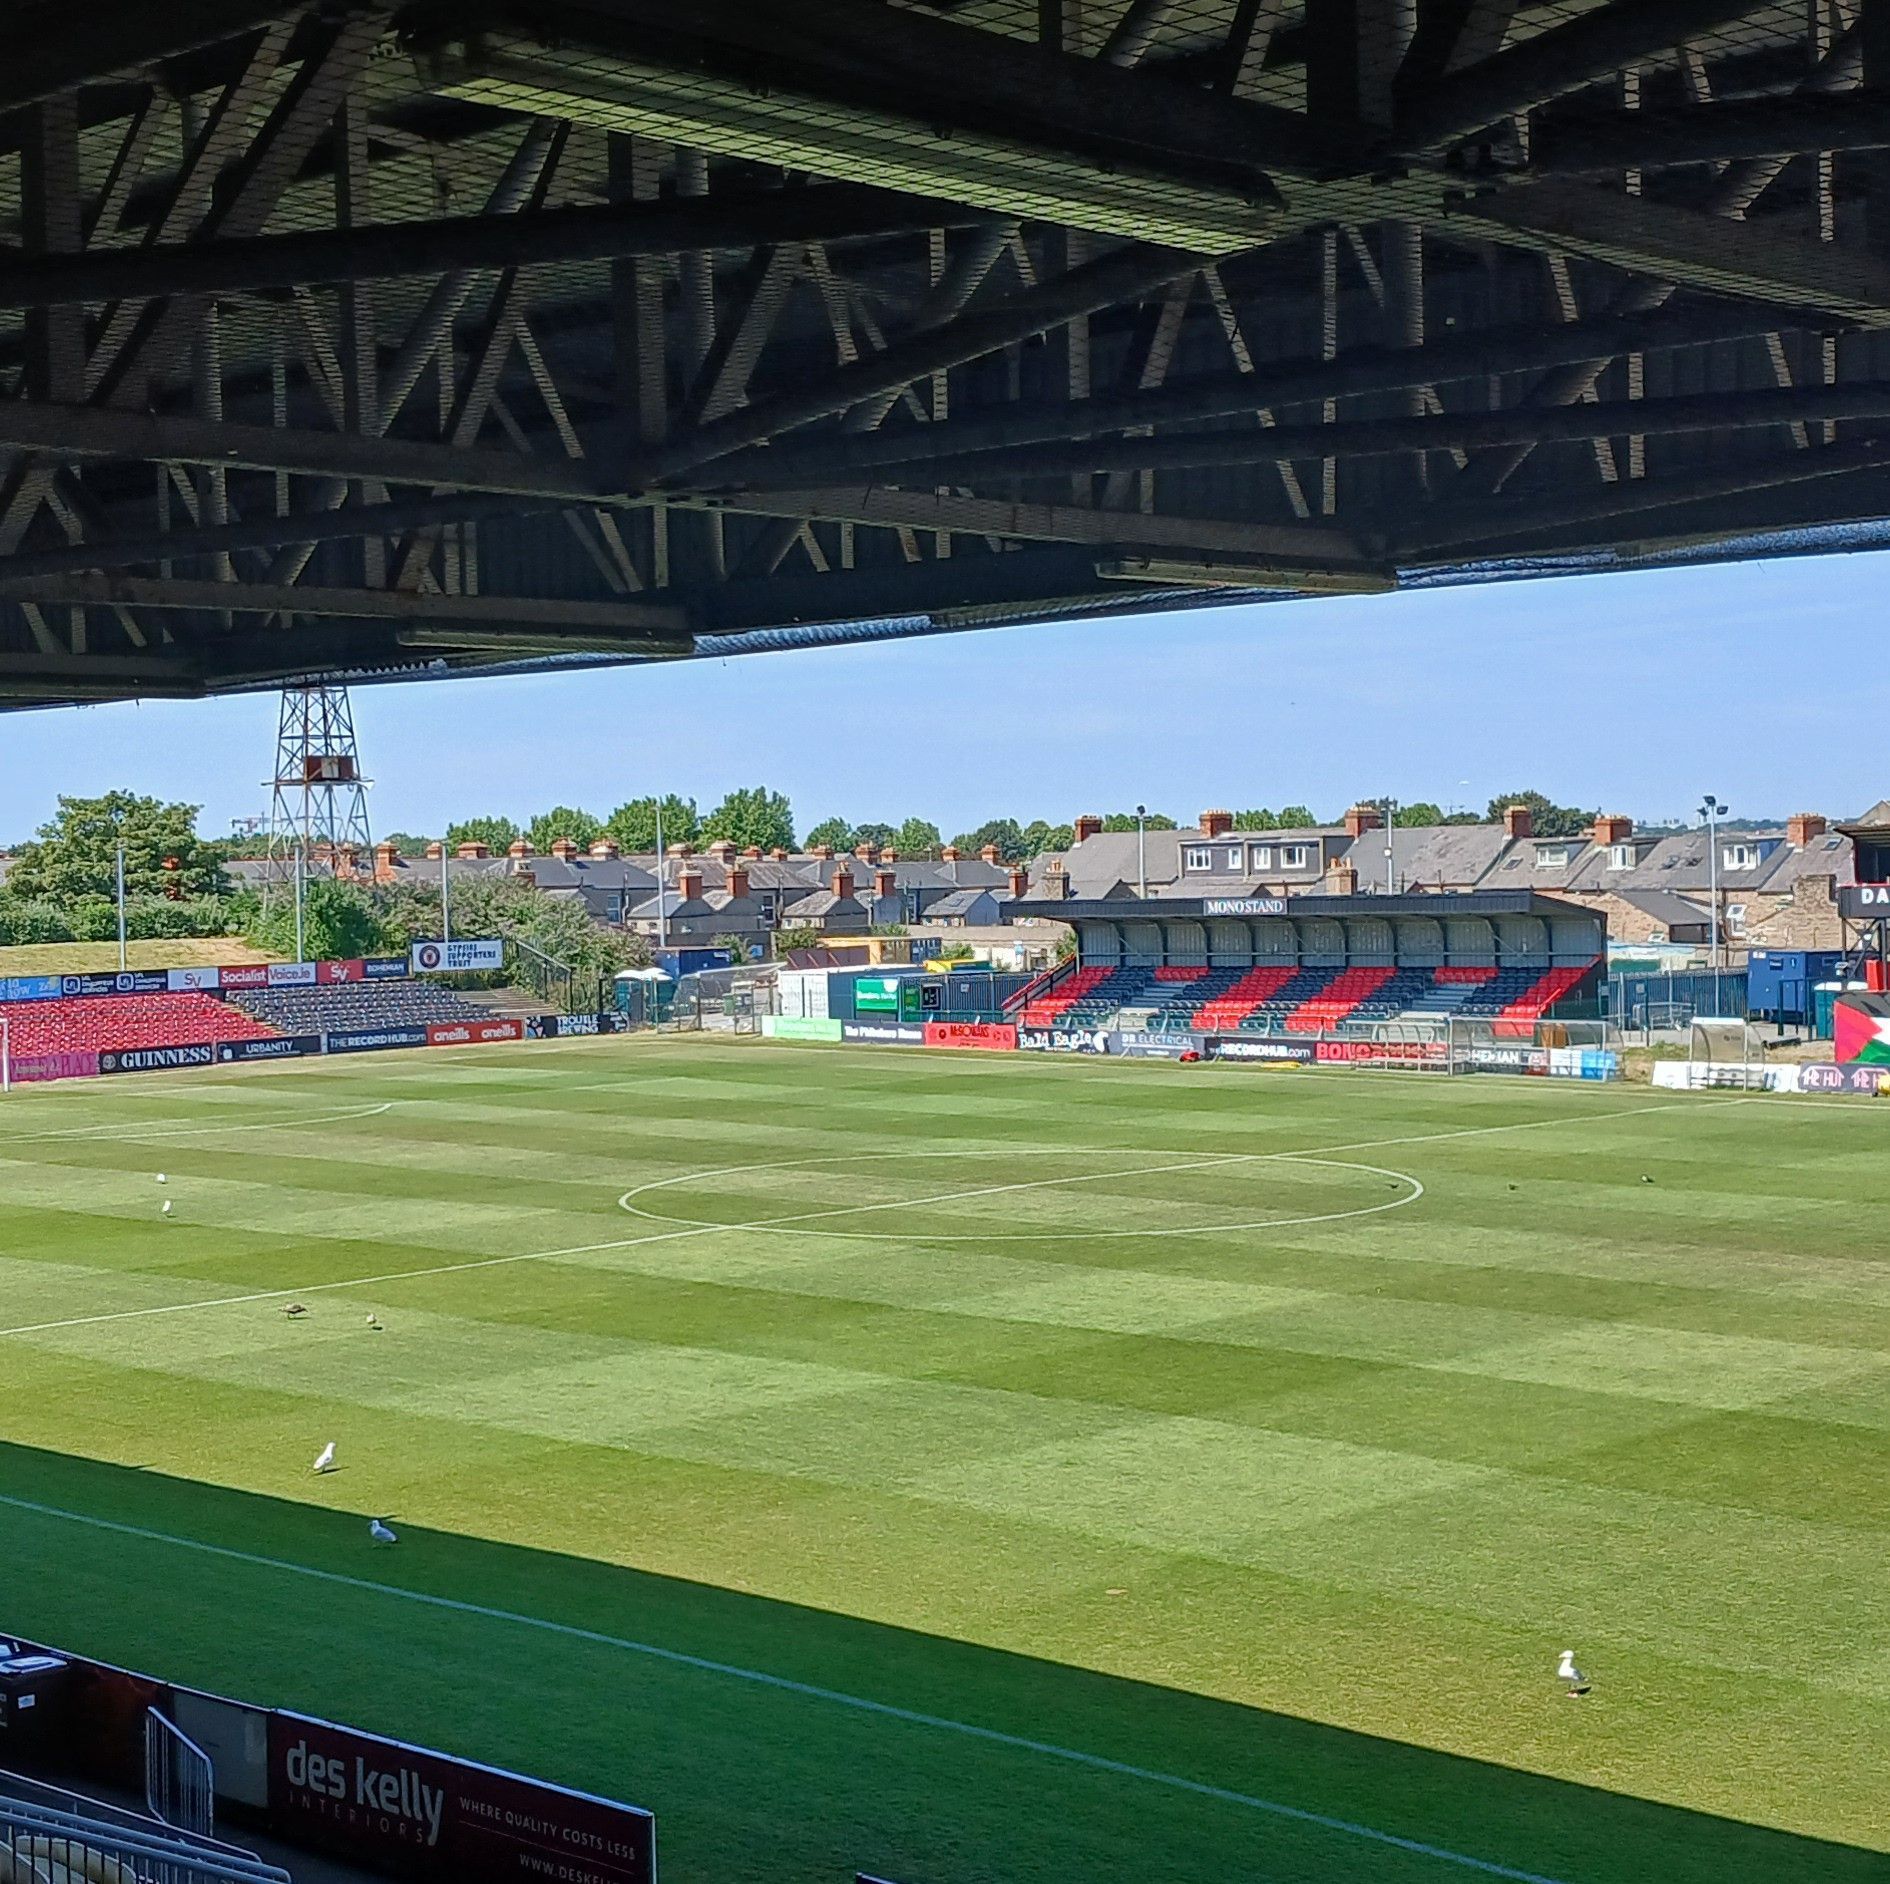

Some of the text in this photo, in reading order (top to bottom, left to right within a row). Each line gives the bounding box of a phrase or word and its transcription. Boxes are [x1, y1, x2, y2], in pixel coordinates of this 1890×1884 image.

[447, 950, 496, 960] SUPPORTERS
[447, 959, 471, 967] TRUST
[221, 969, 266, 984] Socialist
[244, 1040, 293, 1054] URBANITY
[1138, 1034, 1194, 1046] ELECTRICAL
[120, 1046, 211, 1069] GUINNESS
[286, 1739, 444, 1847] des kelly
[289, 1790, 424, 1844] INTERIORS
[459, 1796, 636, 1861] WHERE QUALITY COSTS LESS
